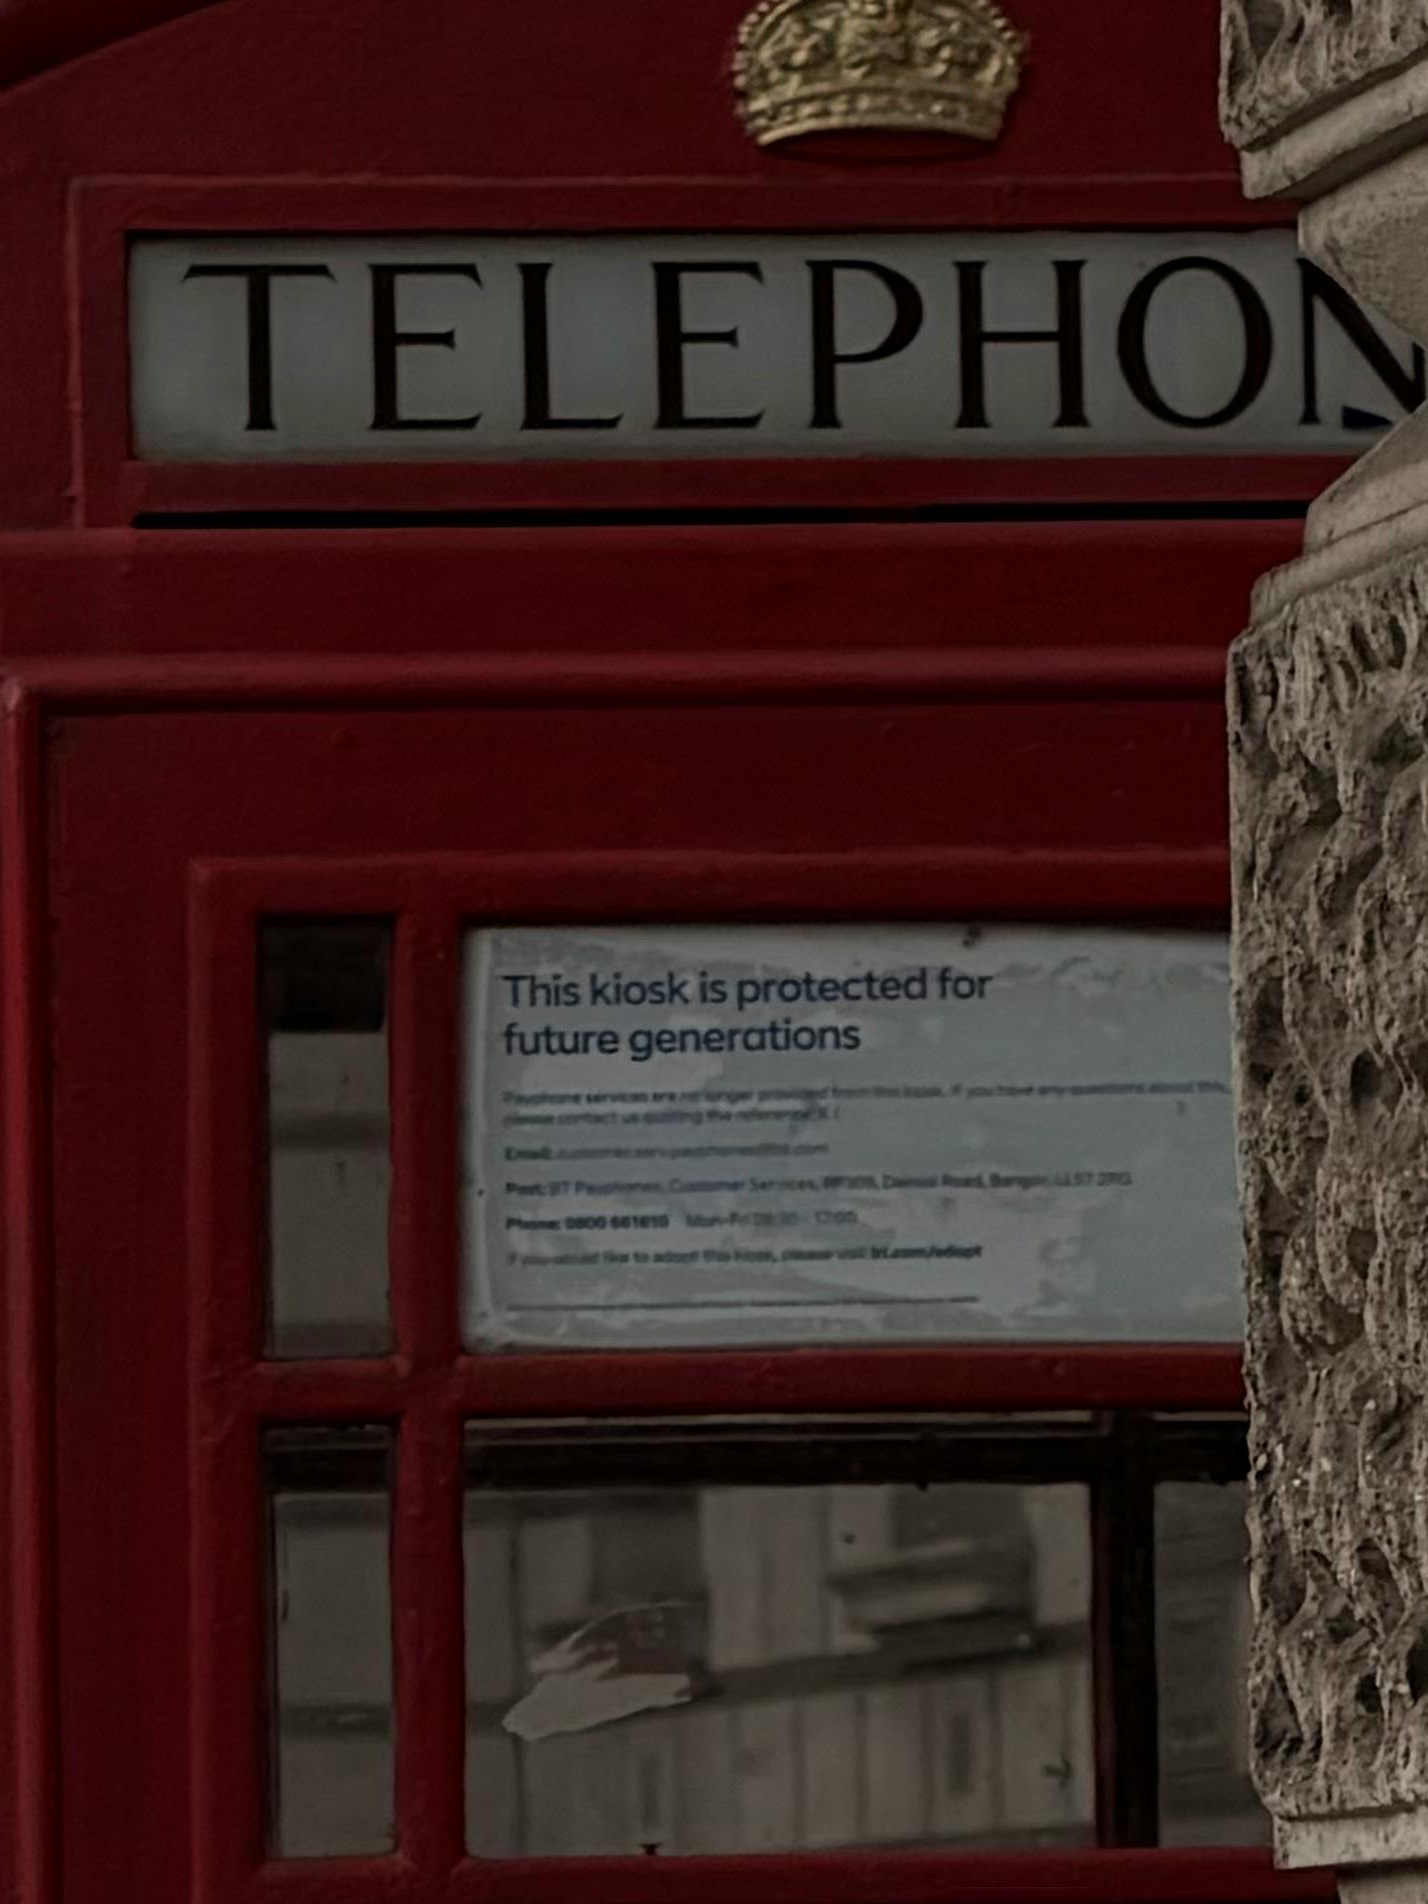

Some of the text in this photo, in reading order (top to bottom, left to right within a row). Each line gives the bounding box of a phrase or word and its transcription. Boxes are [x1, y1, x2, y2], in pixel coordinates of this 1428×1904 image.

[181, 253, 1428, 432] TELEPHON
[503, 966, 994, 1011] This kiosk is protected for
[503, 1017, 862, 1062] future generations
